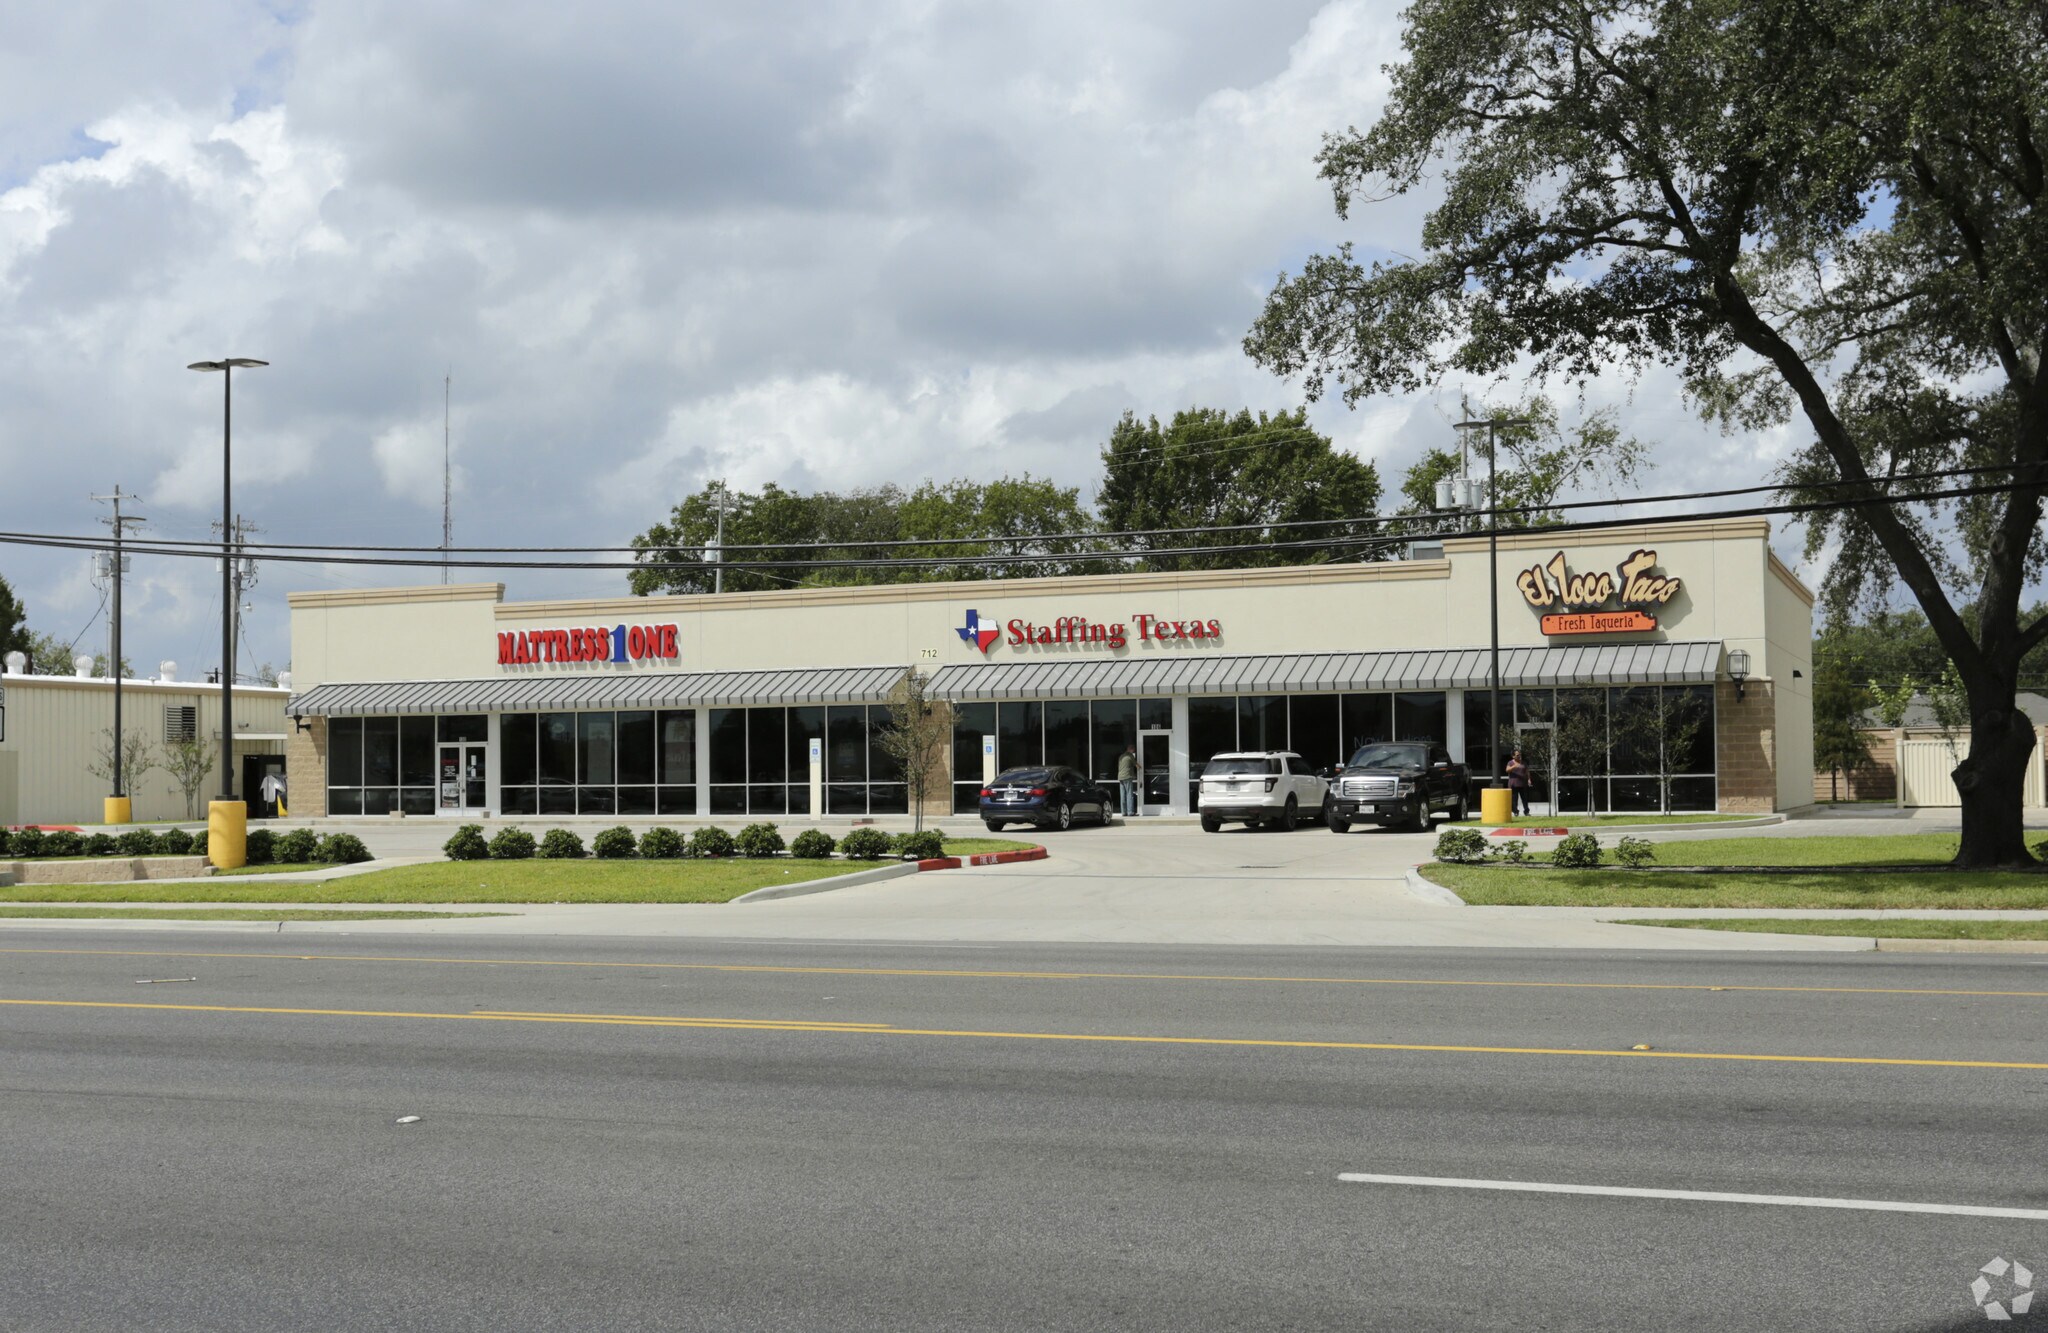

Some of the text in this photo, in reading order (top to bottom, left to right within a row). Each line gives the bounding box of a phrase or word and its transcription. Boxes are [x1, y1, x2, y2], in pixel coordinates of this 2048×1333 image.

[1517, 564, 1554, 606] El
[1617, 549, 1680, 606] Taco
[1007, 614, 1220, 649] Staffing Texas
[1558, 614, 1633, 631] Fresh Taqueria
[497, 627, 610, 664] MATTRESS
[628, 624, 678, 660] ONE
[921, 649, 938, 658] 712
